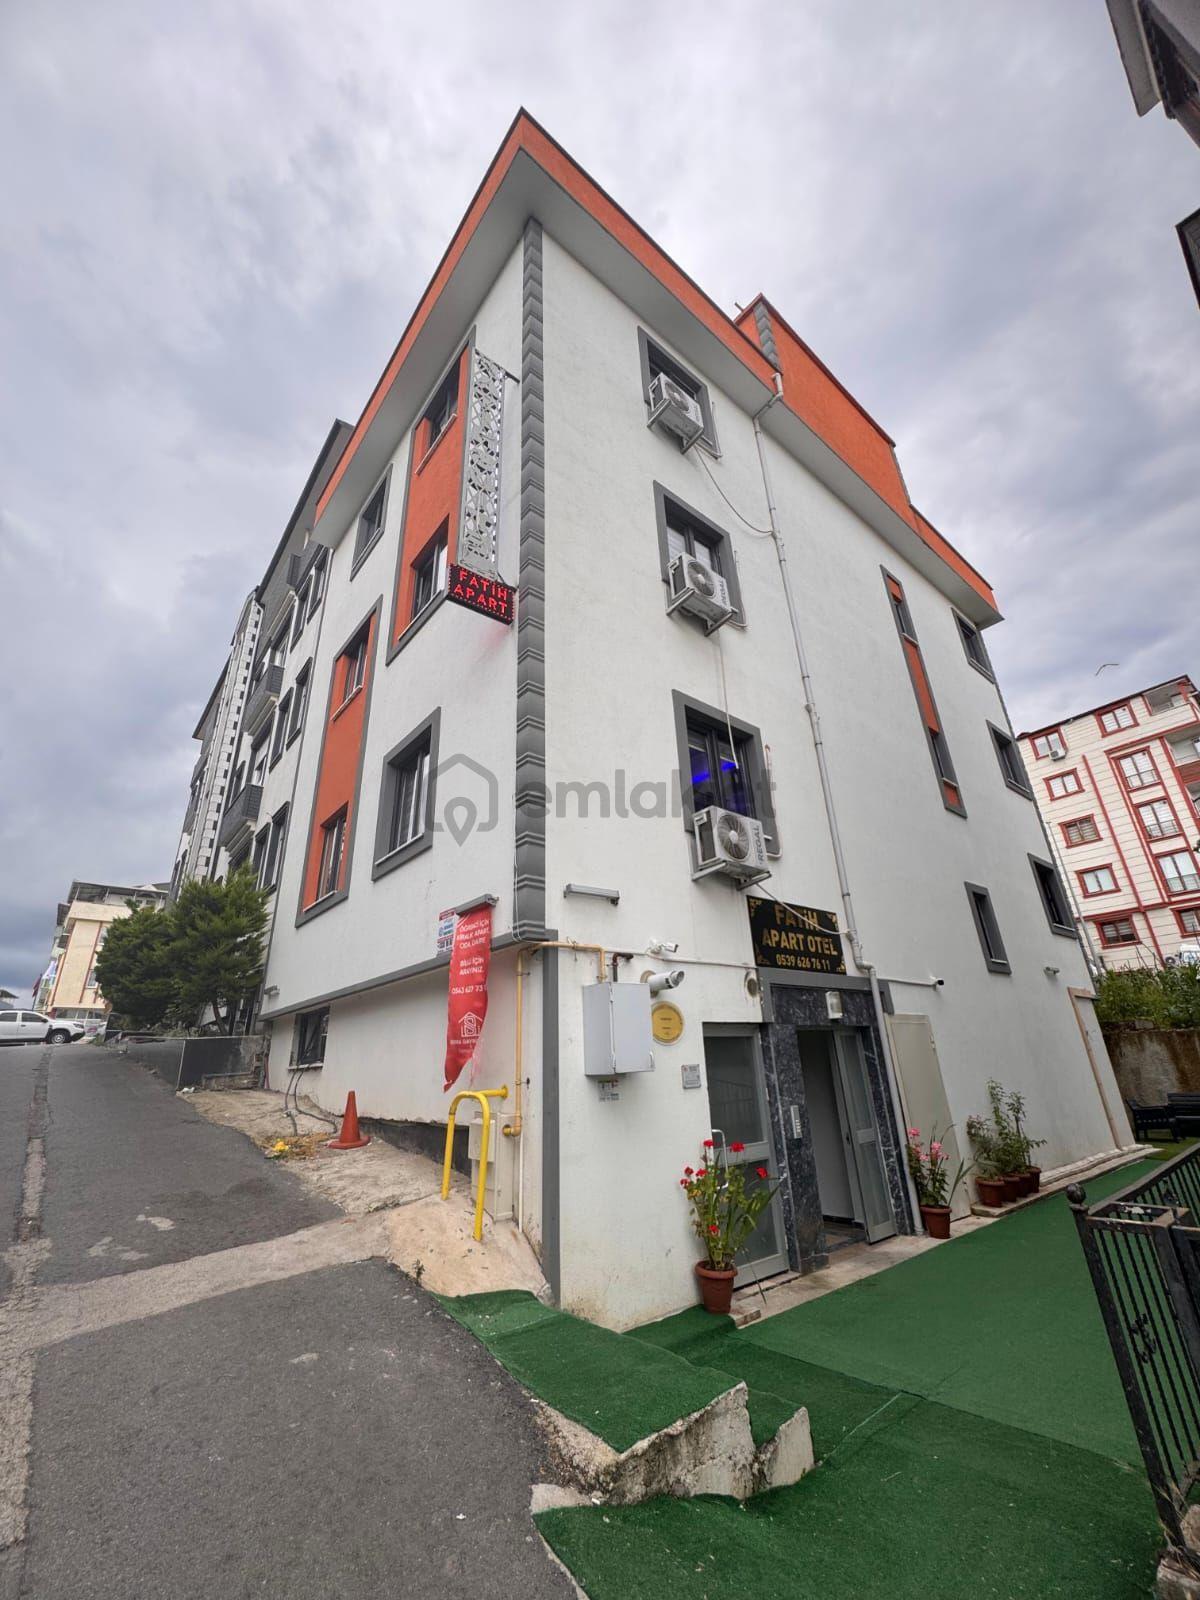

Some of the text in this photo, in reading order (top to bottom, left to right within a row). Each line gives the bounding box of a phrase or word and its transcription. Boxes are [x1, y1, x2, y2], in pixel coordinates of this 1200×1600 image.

[454, 584, 507, 613] APART
[753, 824, 764, 862] REGAL
[762, 928, 838, 955] APART OTEL
[776, 953, 796, 967] 0539
[797, 955, 811, 969] 626
[823, 959, 831, 971] 11
